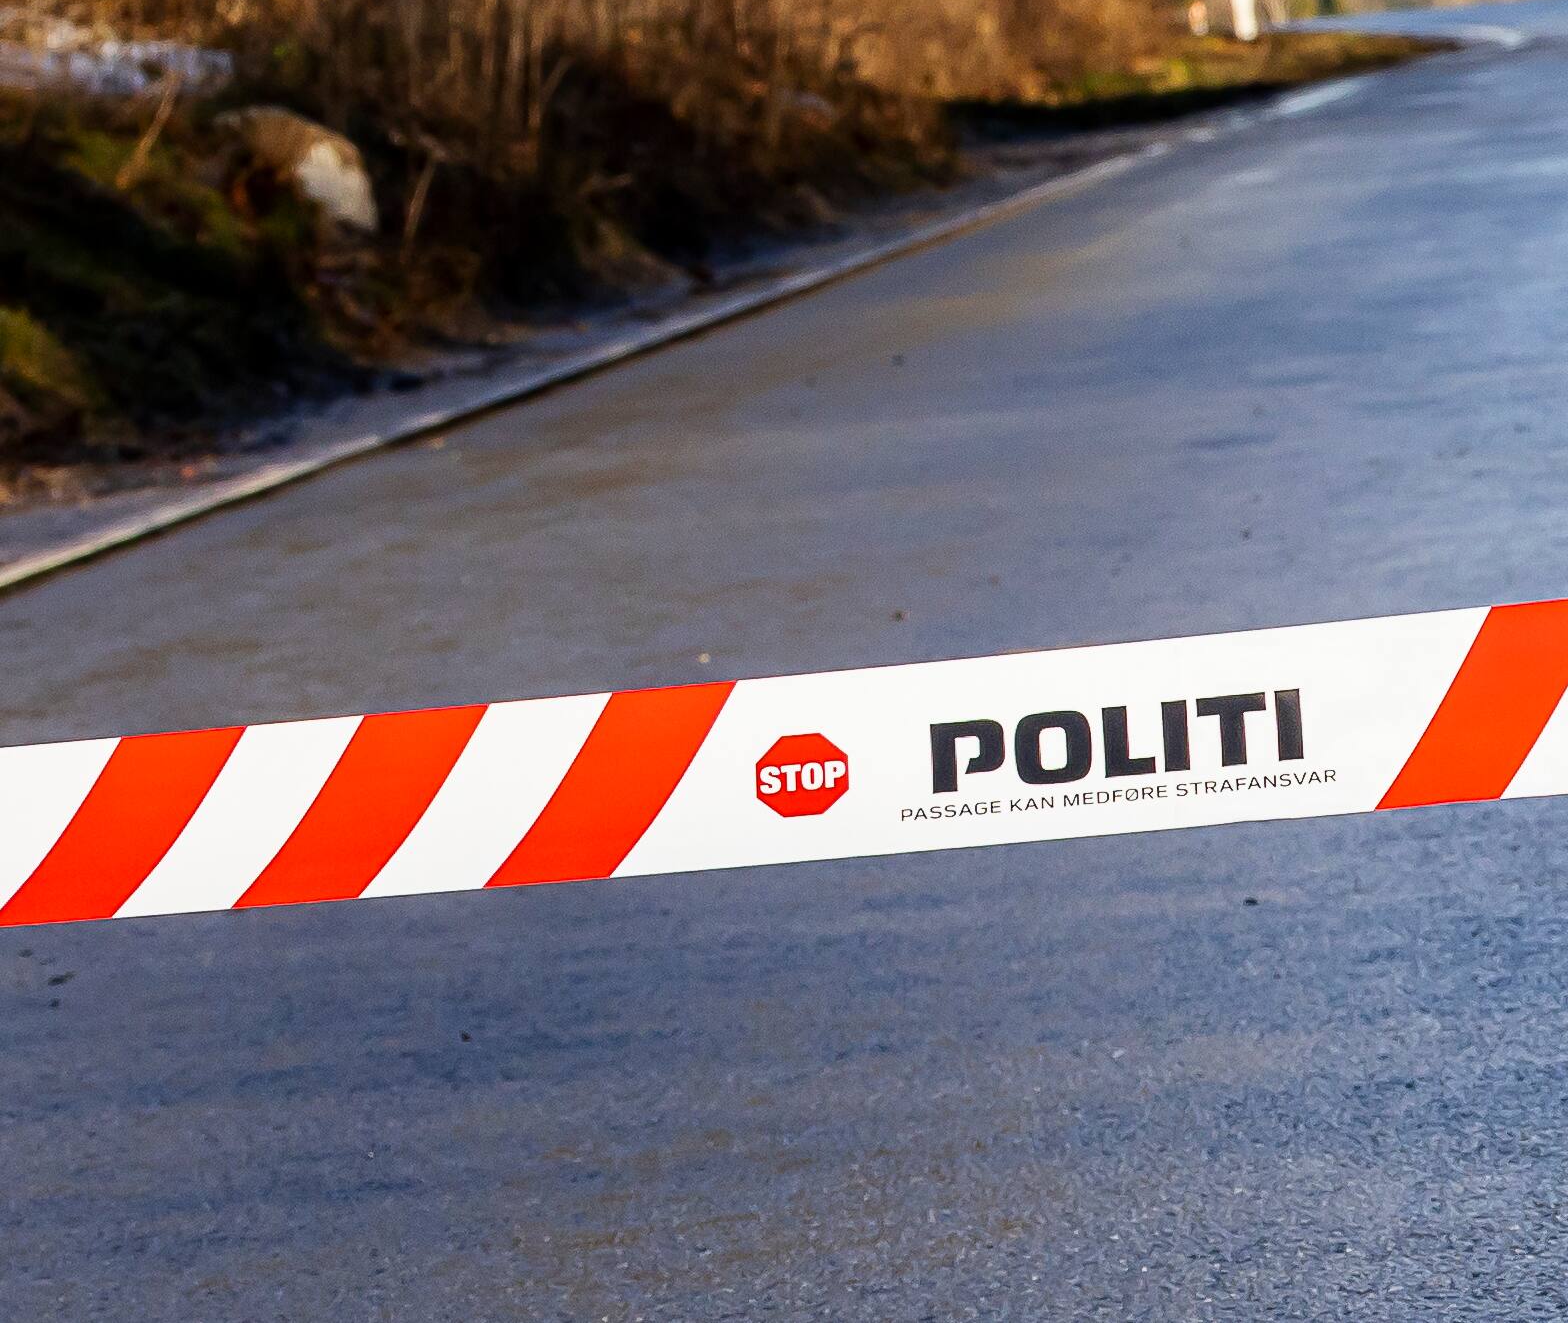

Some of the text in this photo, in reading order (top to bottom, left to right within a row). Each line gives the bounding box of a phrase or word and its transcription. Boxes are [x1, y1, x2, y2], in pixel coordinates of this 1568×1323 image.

[929, 687, 1305, 795] POLITI
[759, 760, 846, 794] STOP
[901, 769, 1337, 822] PASSAGE KAN MEDFØRE STRAFANSVAR
